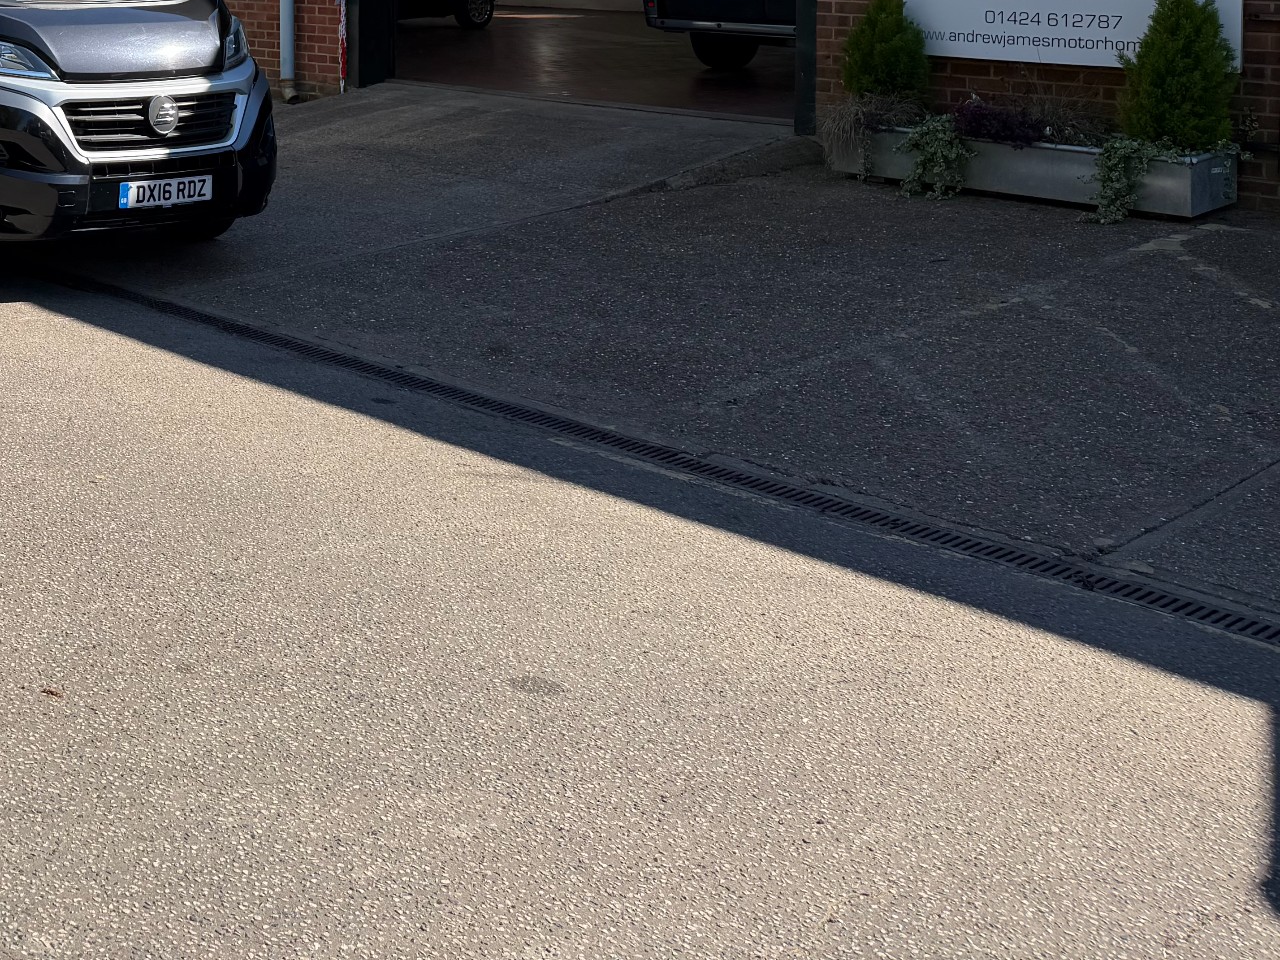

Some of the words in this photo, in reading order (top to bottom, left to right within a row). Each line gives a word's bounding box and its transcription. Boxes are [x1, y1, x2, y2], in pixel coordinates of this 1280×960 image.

[984, 10, 1042, 26] 01424
[1047, 12, 1123, 30] 612787
[135, 182, 173, 204] DX16
[176, 178, 207, 200] RDZ
